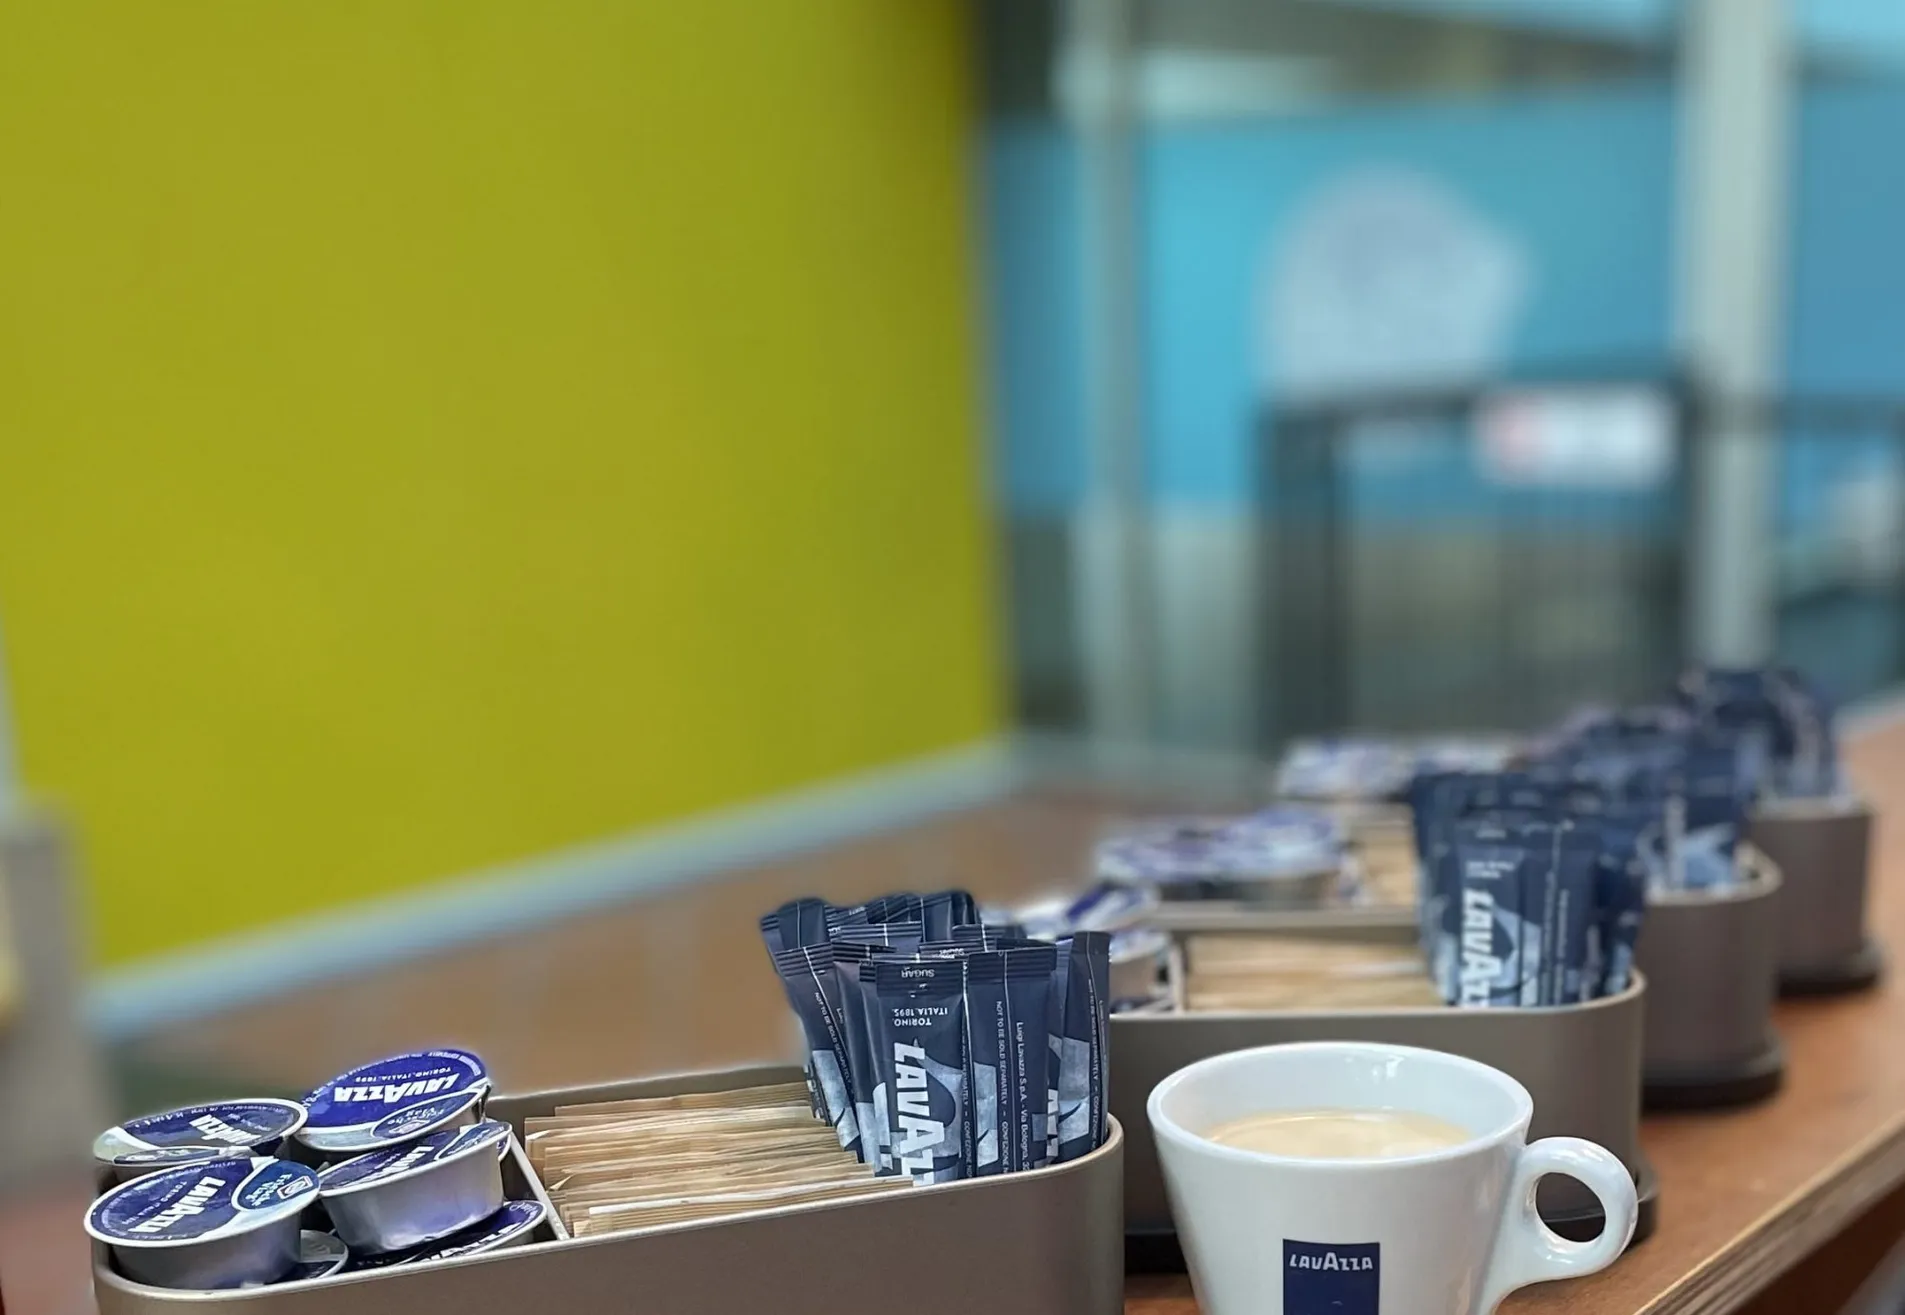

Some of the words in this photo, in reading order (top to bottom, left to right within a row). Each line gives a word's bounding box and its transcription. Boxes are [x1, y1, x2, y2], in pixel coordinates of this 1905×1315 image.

[1462, 888, 1501, 1007] LAVAZ
[901, 968, 935, 978] SUGAR
[996, 1001, 1004, 1016] NOT
[997, 1018, 1004, 1028] TO
[1016, 1022, 1024, 1042] Luigi
[998, 1039, 1006, 1060] SOLD
[1017, 1043, 1025, 1077] Lavazza
[334, 1072, 461, 1104] LAVAZZA
[1020, 1109, 1028, 1123] Via
[1288, 1251, 1374, 1271] LAVAZZA
